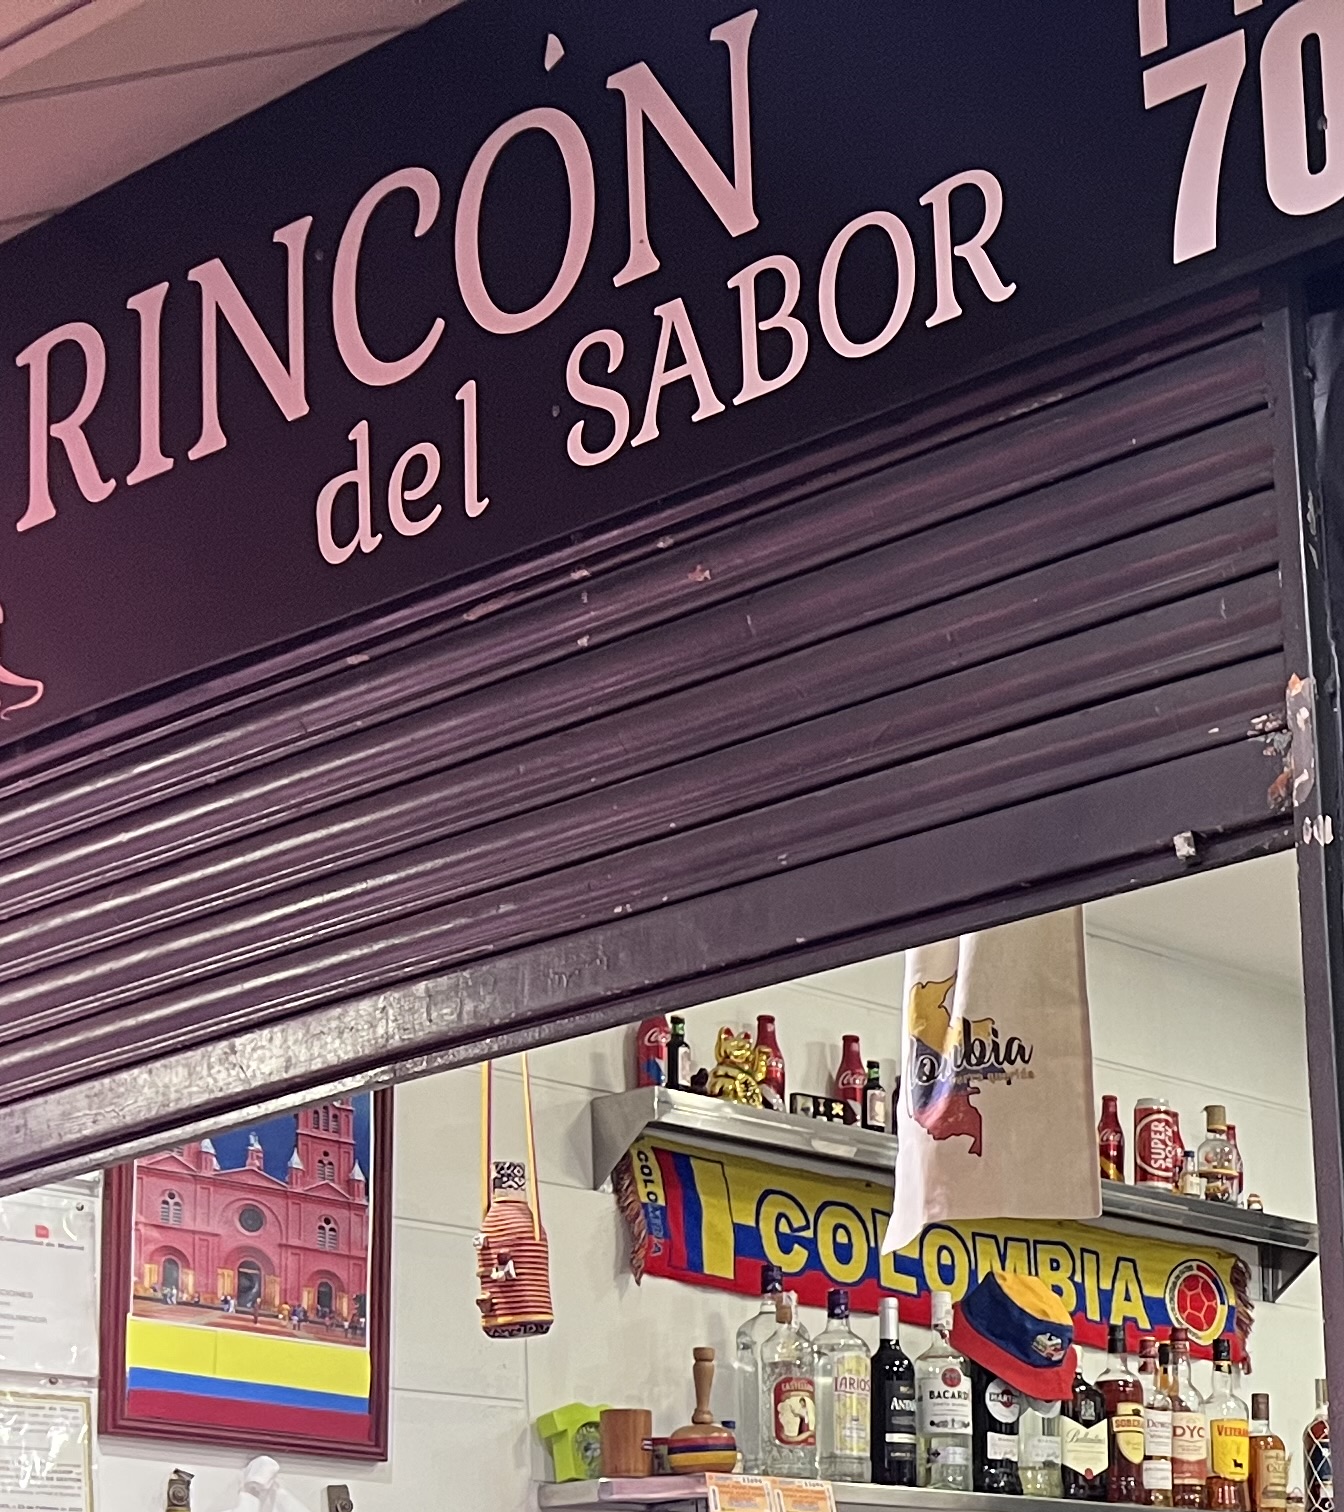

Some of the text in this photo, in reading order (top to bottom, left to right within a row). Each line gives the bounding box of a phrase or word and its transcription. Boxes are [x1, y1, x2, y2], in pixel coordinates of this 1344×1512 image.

[15, 8, 759, 534] RINCÓN
[315, 168, 1017, 567] del SABOR
[1150, 1121, 1166, 1169] SUPER
[834, 1376, 871, 1393] LARIOS
[1172, 1425, 1205, 1439] DYC
